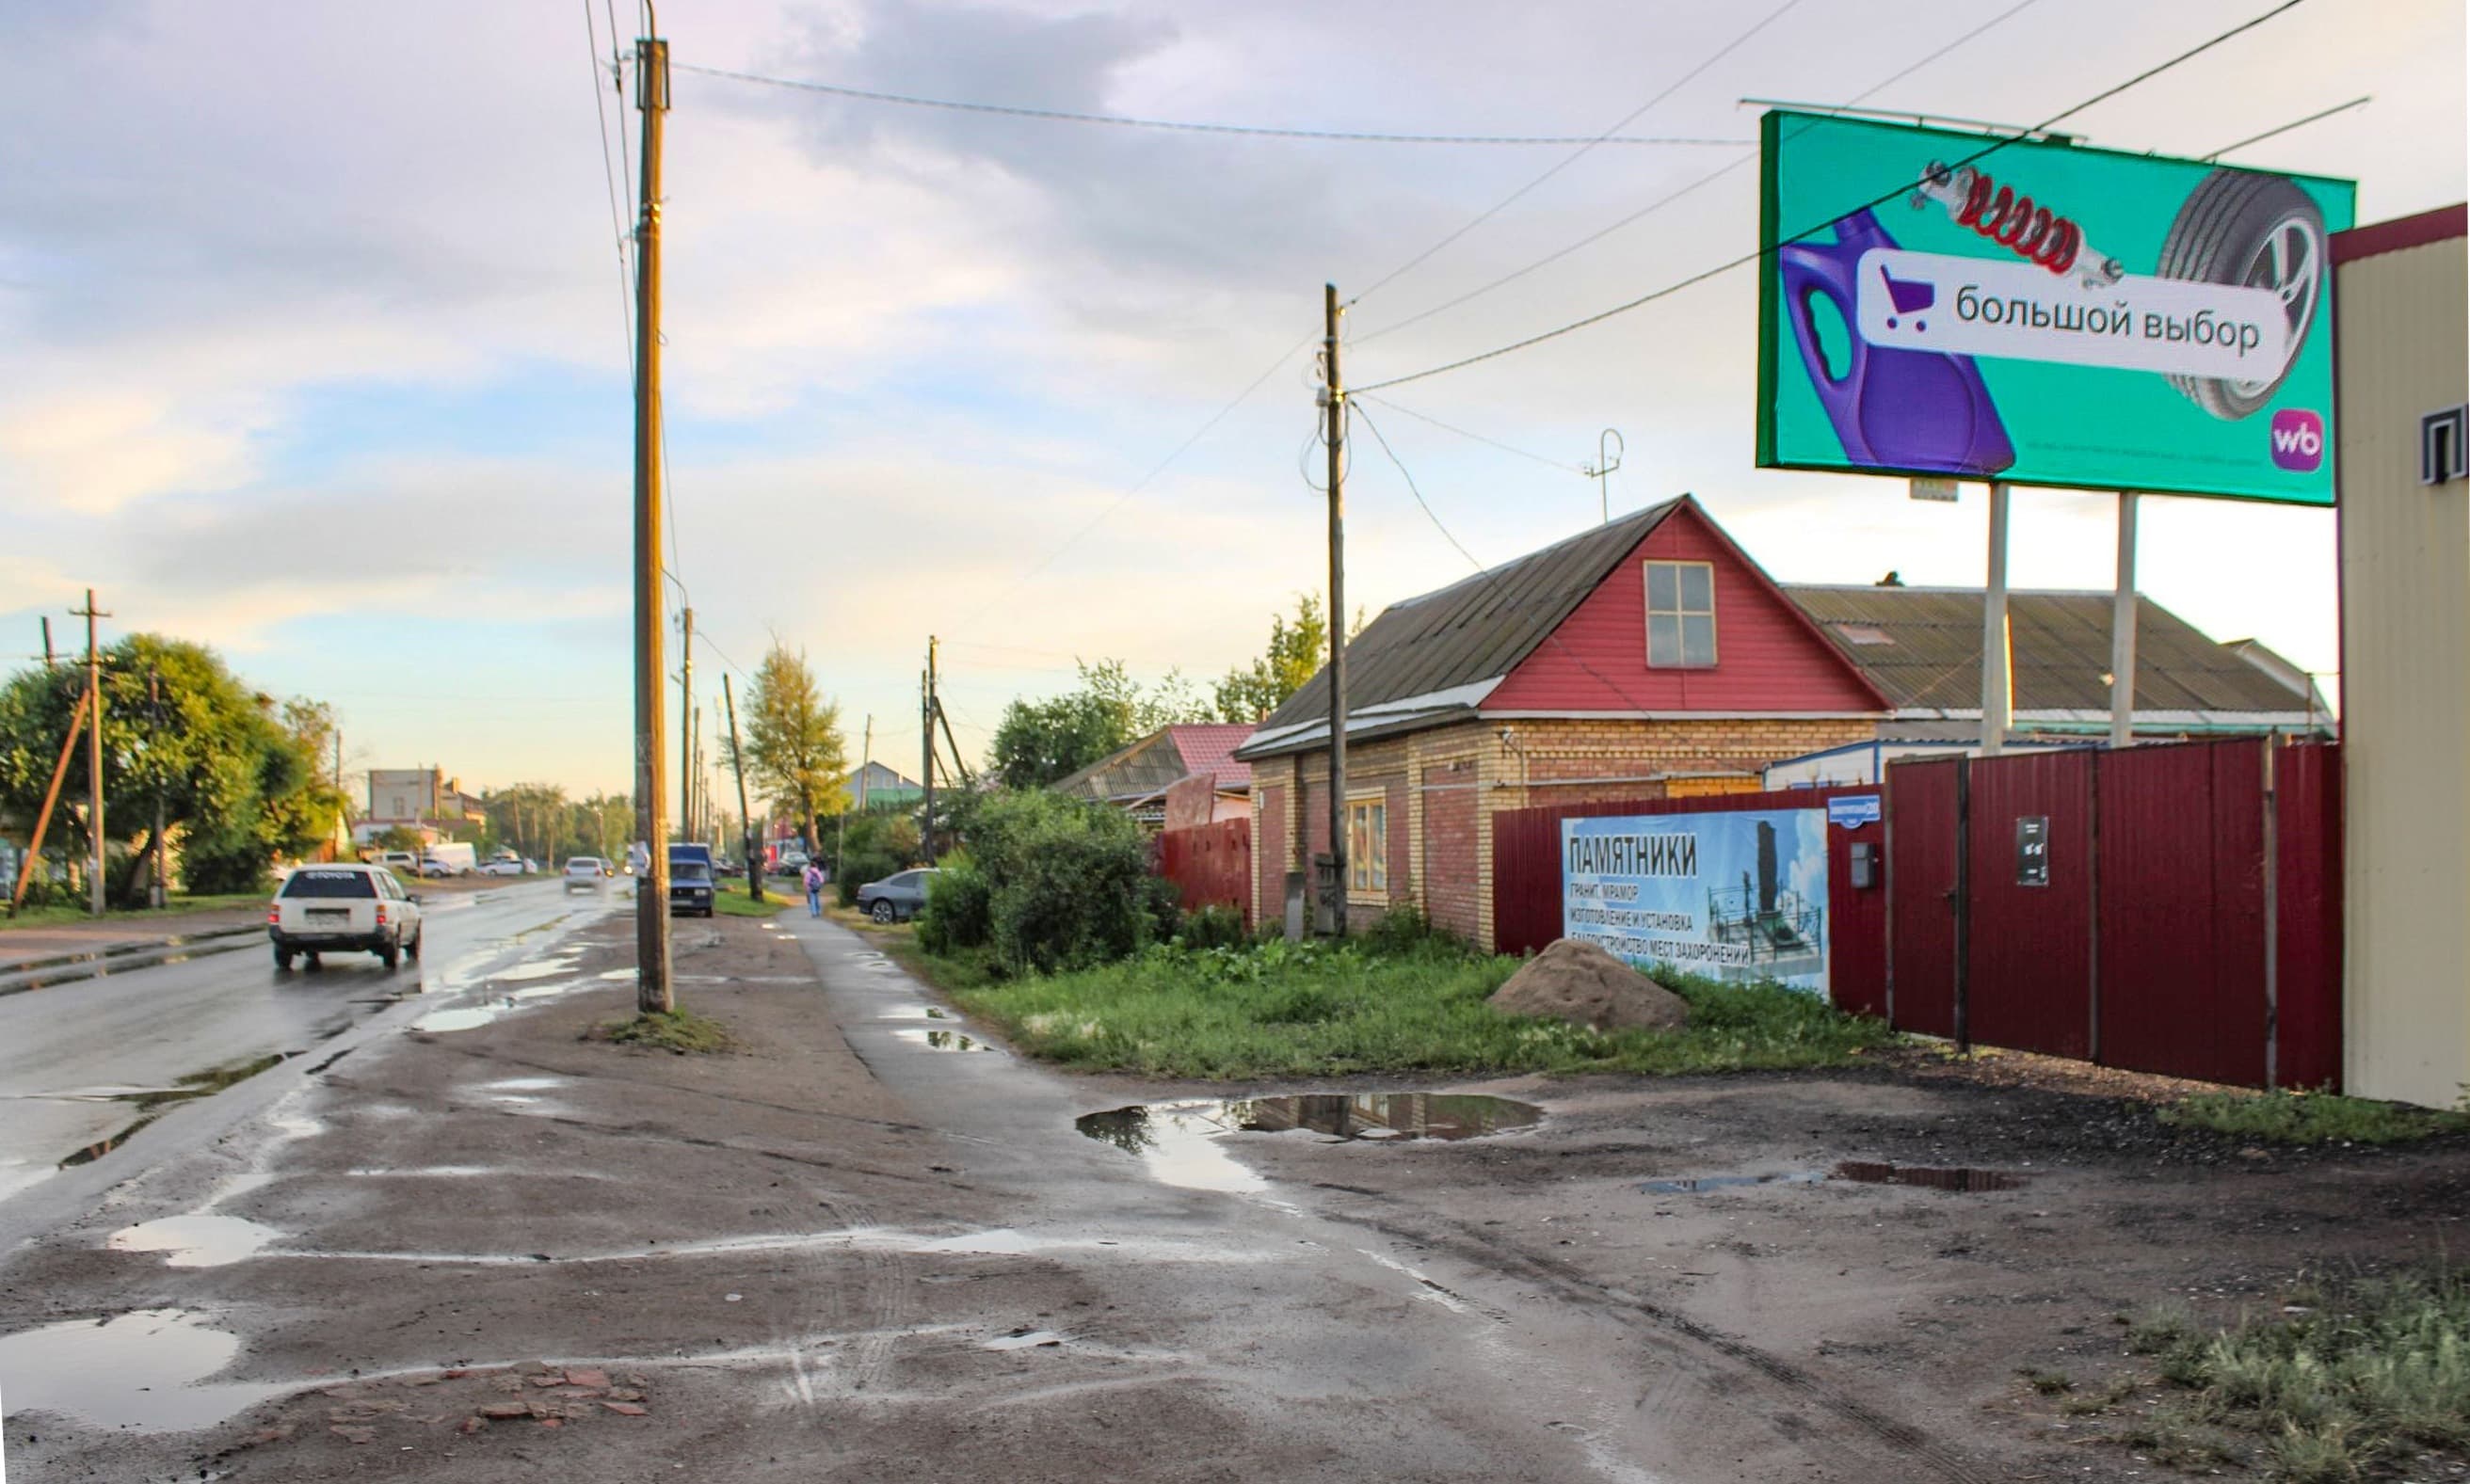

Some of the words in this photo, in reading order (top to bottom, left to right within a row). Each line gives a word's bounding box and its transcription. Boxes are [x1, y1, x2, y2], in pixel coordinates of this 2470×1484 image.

[1956, 284, 2132, 336] большой
[2144, 309, 2260, 358] выбор
[2273, 422, 2321, 456] wb
[1569, 834, 1697, 876] ПАМЯТНИКИ
[1603, 884, 1639, 902] МРАМОР
[1570, 907, 1632, 928] ИЗГОТОВЛЕНИЕ
[1632, 911, 1640, 929] И
[1641, 911, 1693, 932] УСТАНОВКА
[1649, 939, 1674, 957] МЕСТ
